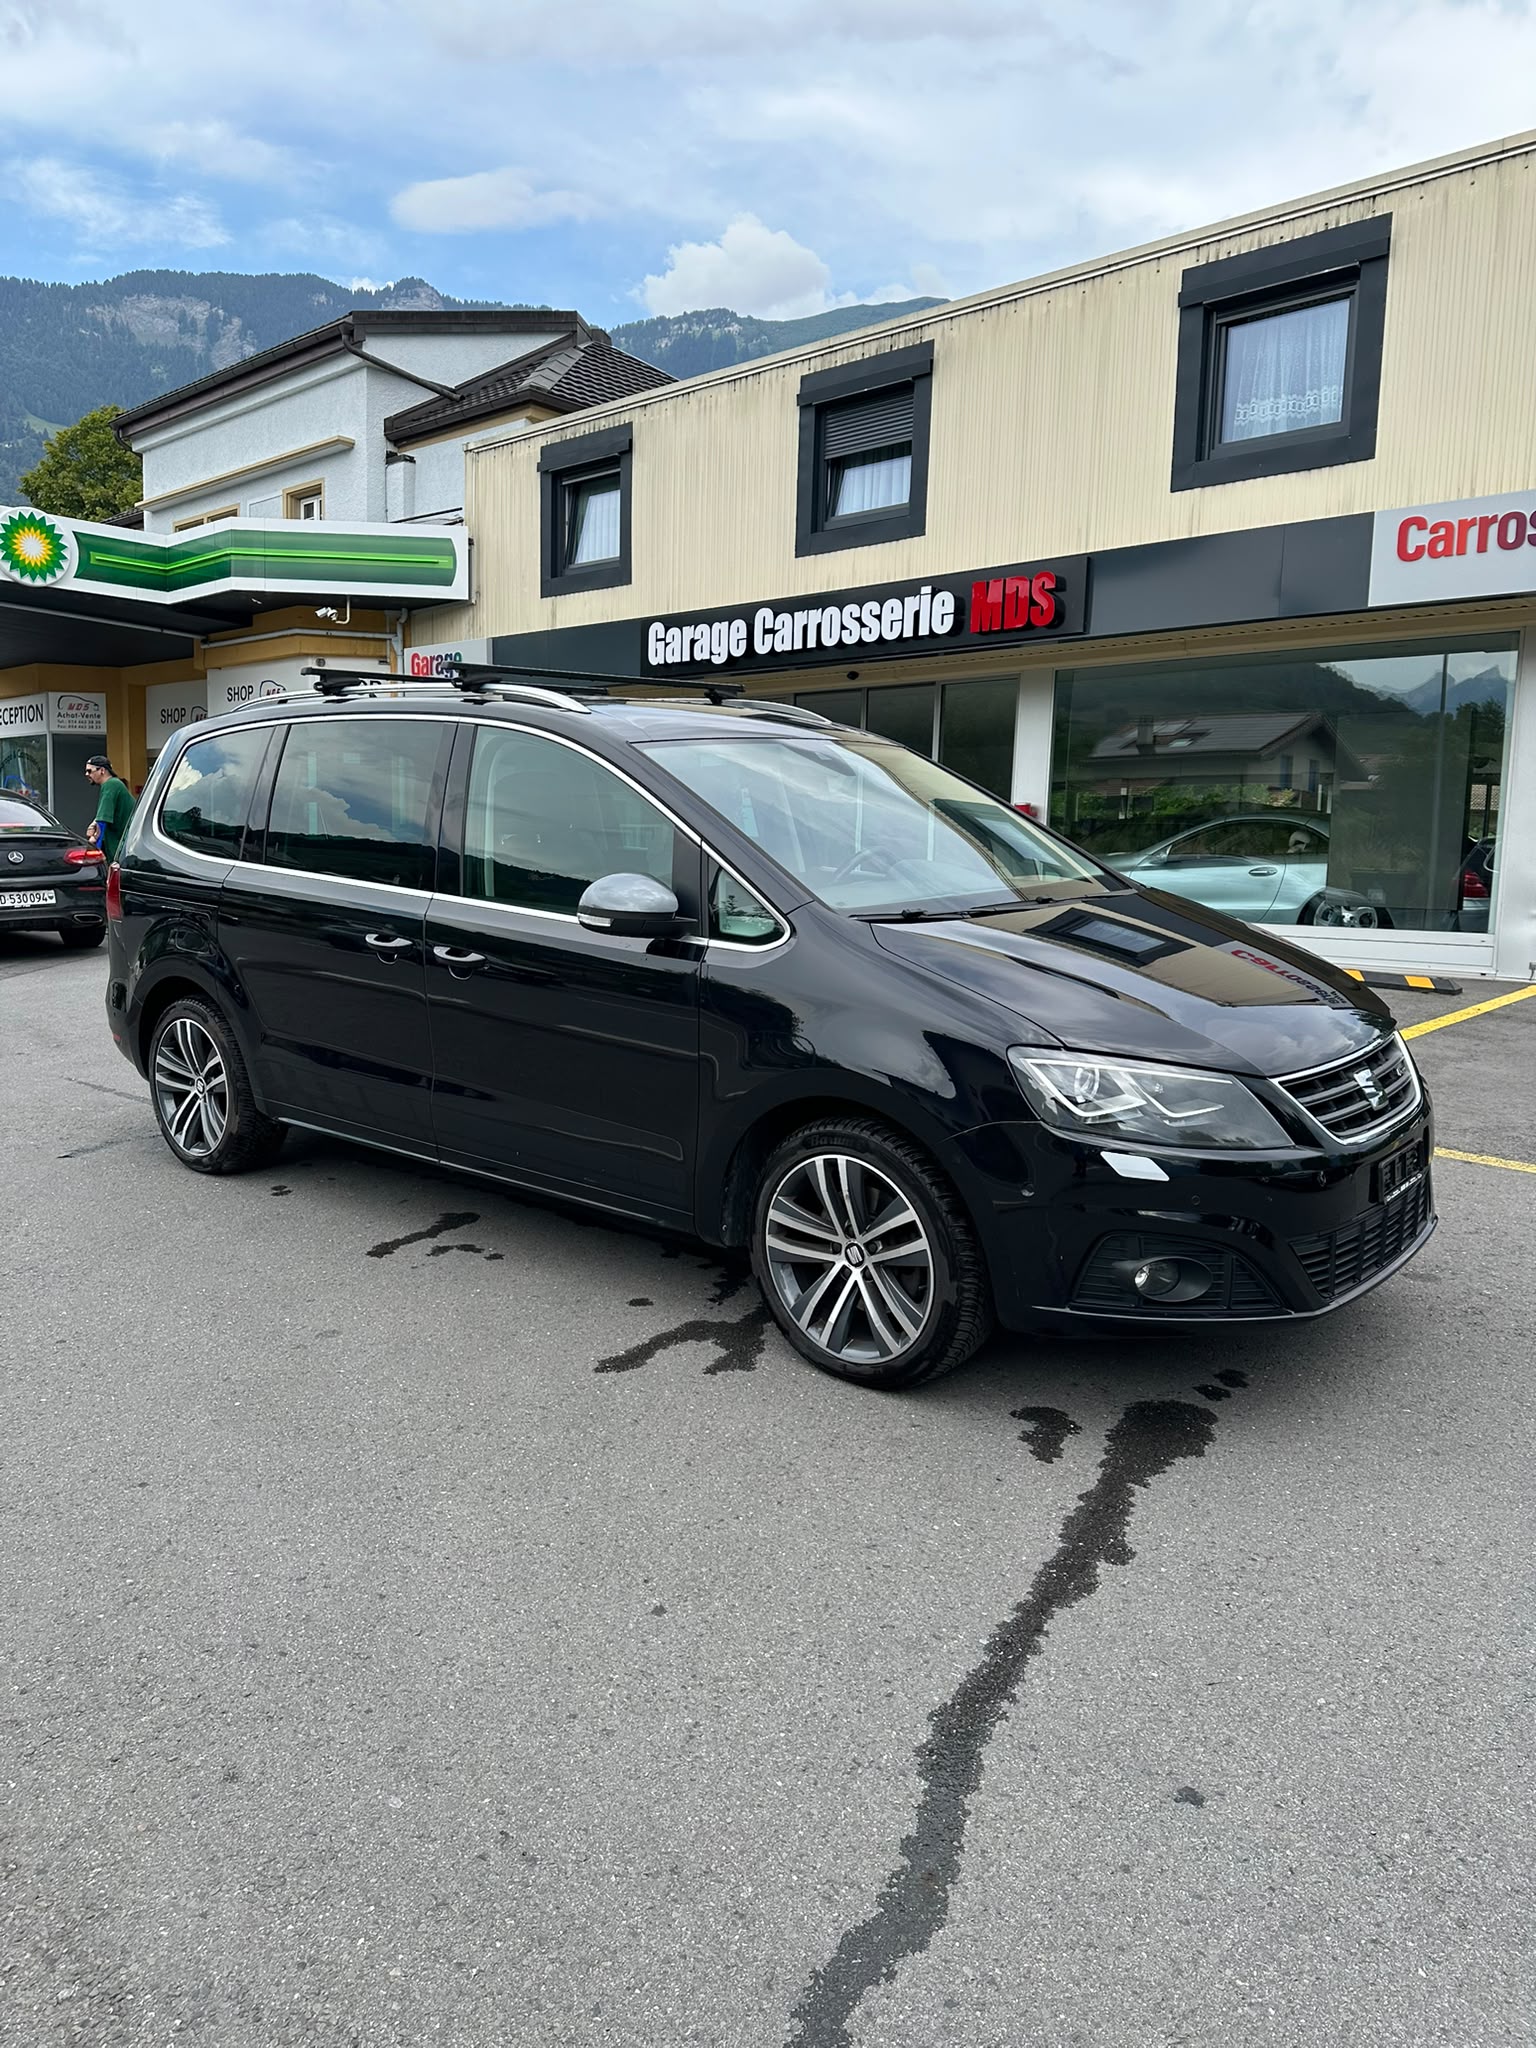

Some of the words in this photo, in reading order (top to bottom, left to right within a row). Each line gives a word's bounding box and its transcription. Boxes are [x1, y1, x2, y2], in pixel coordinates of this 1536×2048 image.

[648, 617, 746, 665] Garage
[754, 586, 955, 655] Carrosserie
[969, 571, 1057, 633] MDS
[227, 685, 254, 702] SHOP
[160, 707, 187, 724] SHOP
